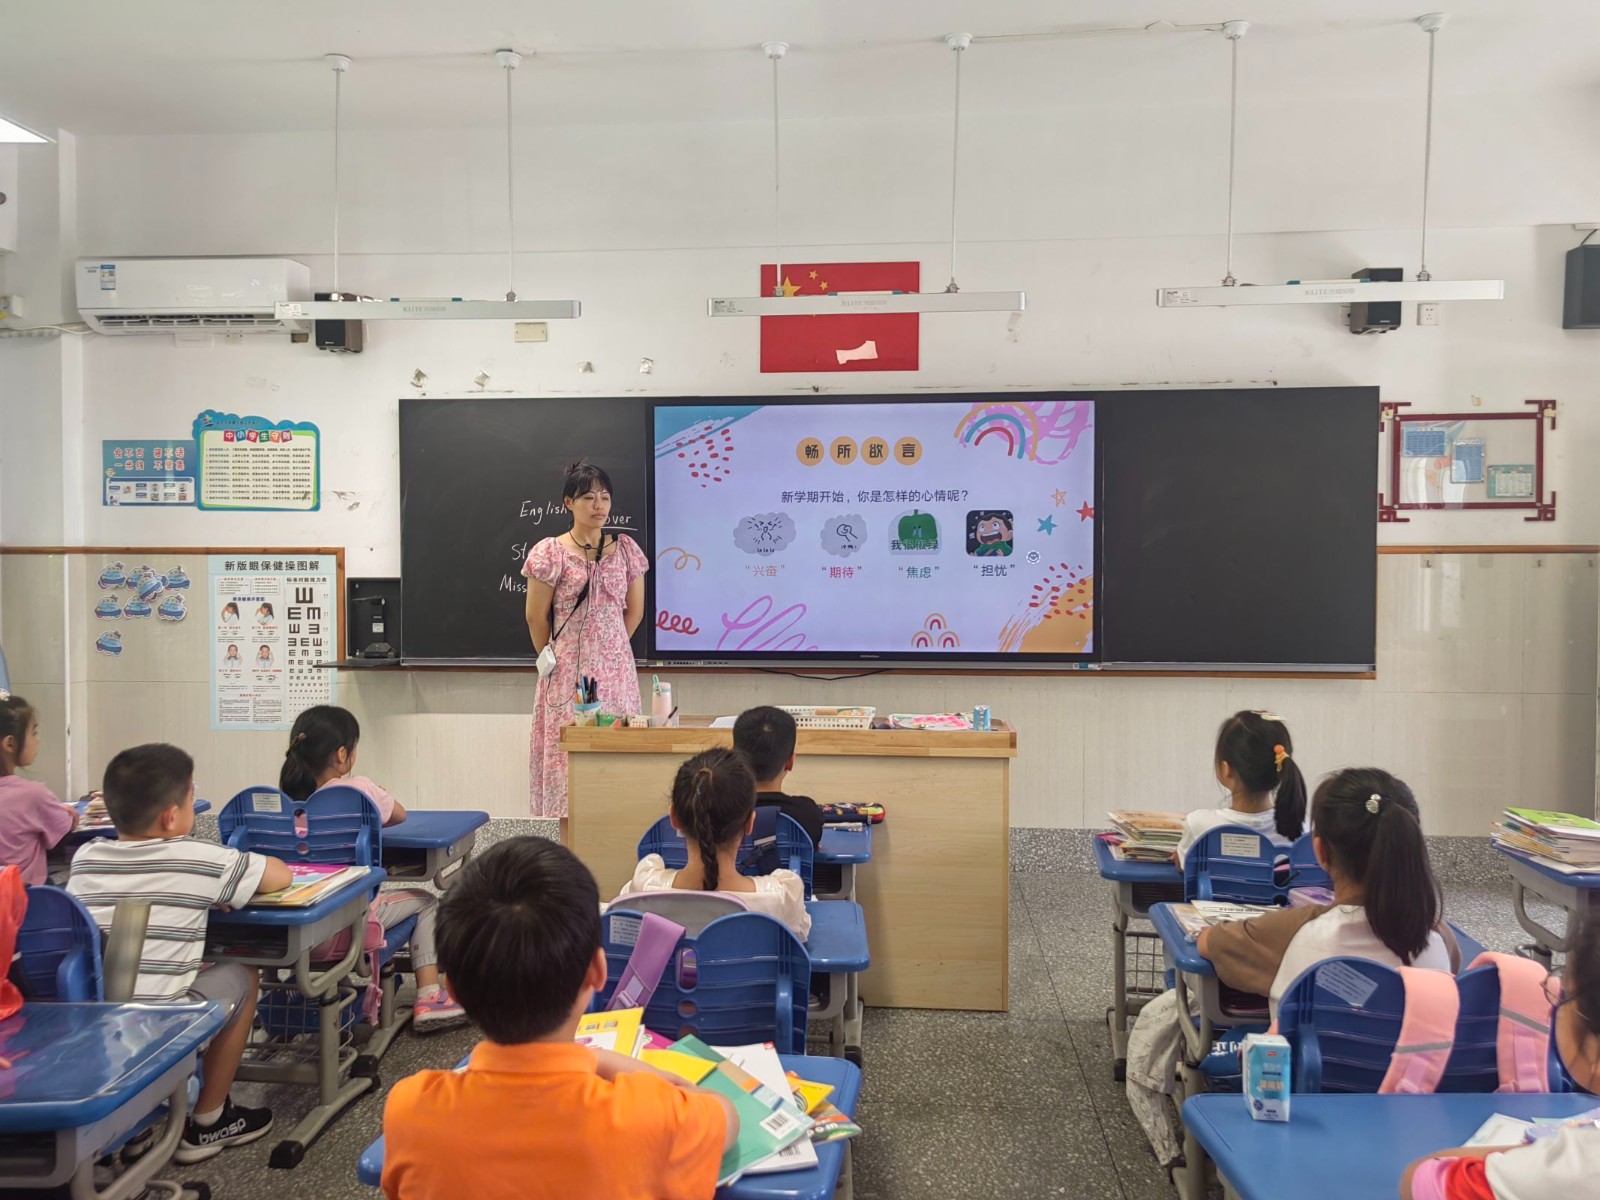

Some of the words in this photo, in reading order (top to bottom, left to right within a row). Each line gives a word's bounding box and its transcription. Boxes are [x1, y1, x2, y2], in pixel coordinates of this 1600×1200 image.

[225, 430, 291, 441] 中小学生守则
[802, 441, 919, 461] 畅所欲言
[224, 560, 320, 571] 新版眼保健操图解
[198, 1118, 247, 1145] bwasp
